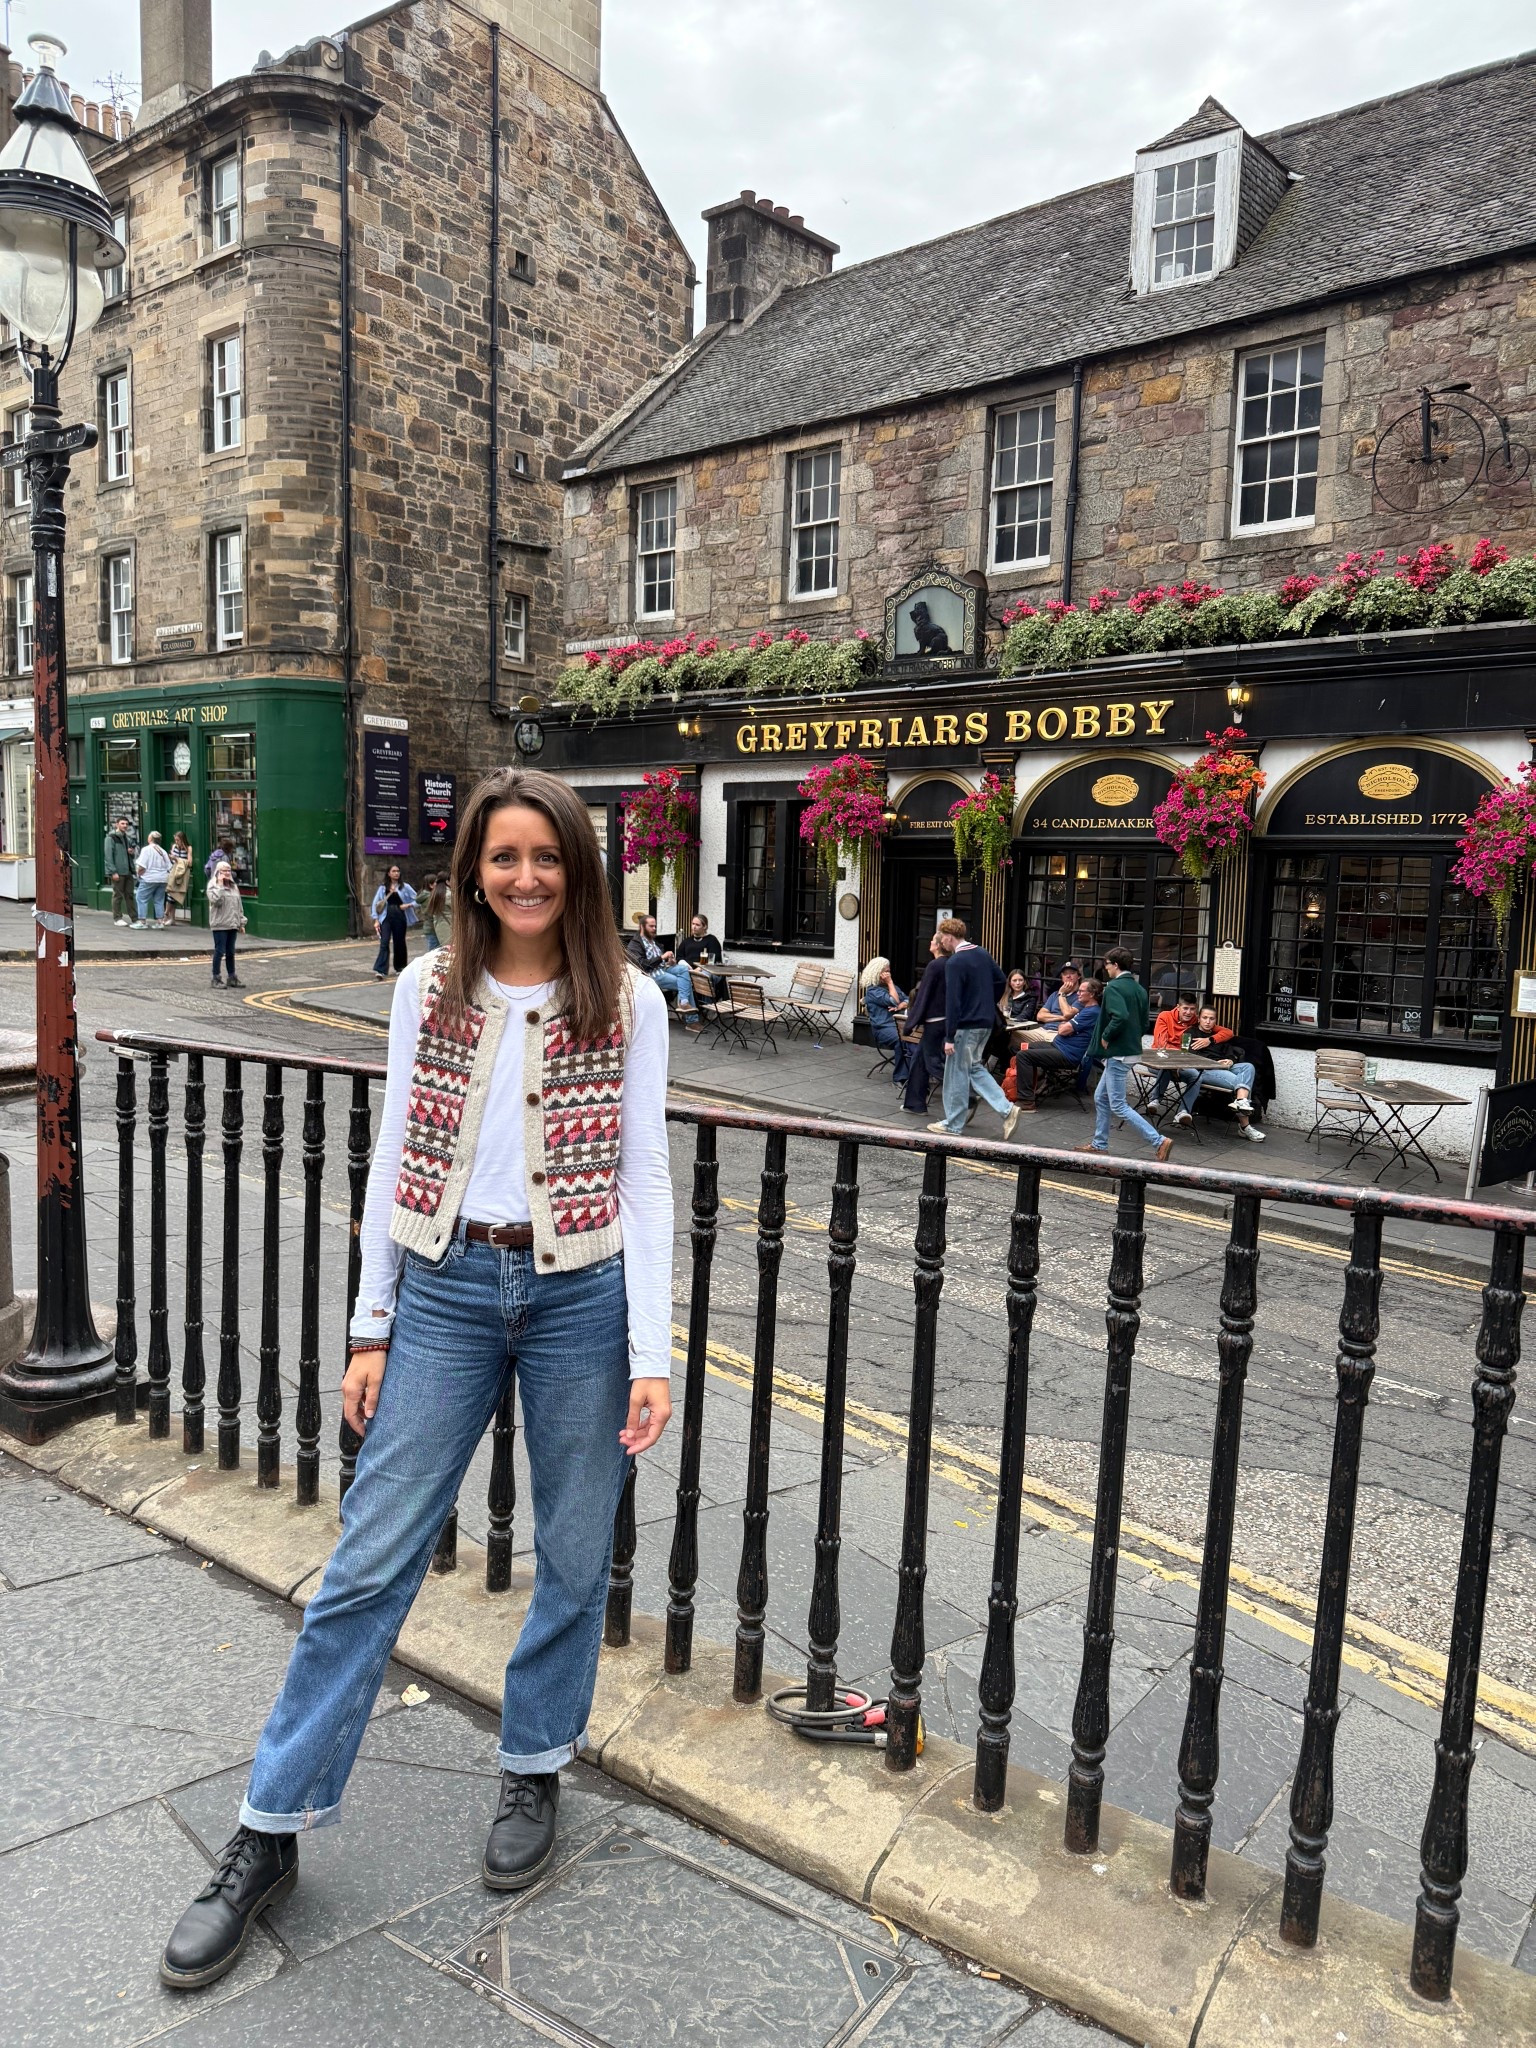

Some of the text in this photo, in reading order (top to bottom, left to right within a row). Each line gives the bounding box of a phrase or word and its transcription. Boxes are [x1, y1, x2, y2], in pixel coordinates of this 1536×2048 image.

[162, 640, 192, 651] GRASSMARKET
[932, 659, 957, 670] BOBBY
[112, 705, 228, 728] GREYFRIARS ART SHOP
[366, 716, 406, 729] GREYFRIARS
[736, 700, 1174, 753] GREYFRIARS BOBBY
[372, 748, 403, 757] GREYFRIARS
[424, 779, 453, 790] Historic
[1366, 776, 1410, 787] NICHOLSON'S
[425, 787, 451, 797] Church
[1032, 818, 1155, 829] 34 CANDLEMAKER
[1304, 813, 1468, 825] ESTABLISHED 1772
[910, 821, 926, 829] FIRE
[926, 821, 943, 829] EXIT
[1273, 1006, 1284, 1014] FRI
